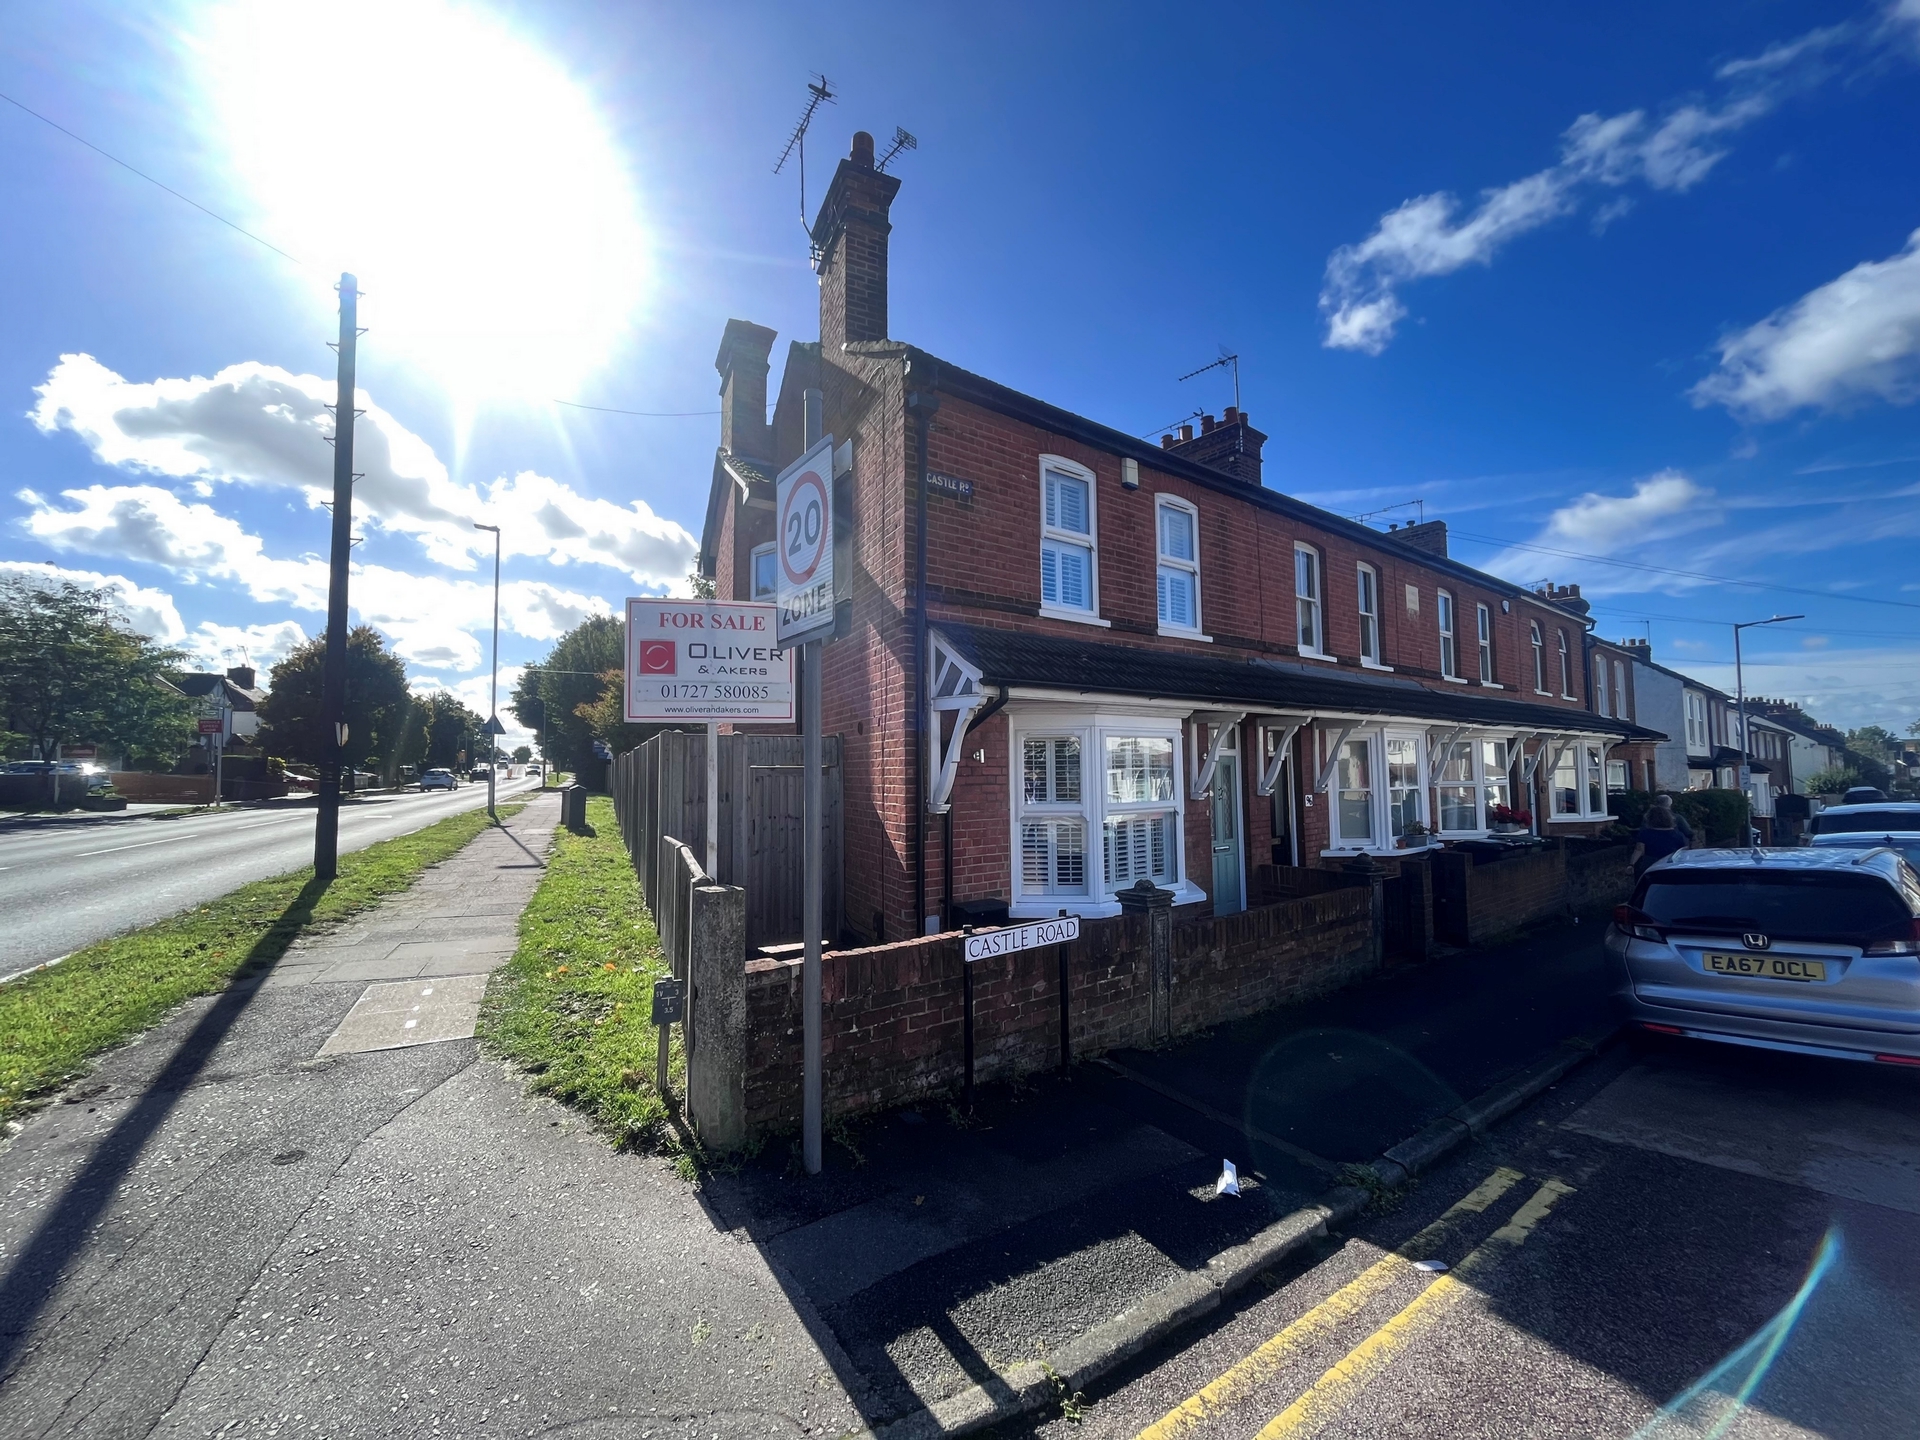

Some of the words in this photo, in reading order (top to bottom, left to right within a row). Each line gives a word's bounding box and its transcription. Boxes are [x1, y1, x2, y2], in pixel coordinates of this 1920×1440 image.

[926, 472, 957, 490] CASTLE
[788, 499, 820, 557] 20
[782, 582, 827, 627] ZONE
[659, 612, 705, 629] FOR
[710, 613, 766, 632] SALE
[688, 643, 784, 662] OLIVER
[697, 664, 710, 675] &
[716, 665, 768, 676] AKERS
[660, 684, 709, 699] 01727
[713, 685, 769, 700] 580085
[664, 706, 760, 714] www.oliverandakers.com
[968, 929, 1028, 958] CASTLE
[1036, 921, 1076, 944] ROAD
[1711, 955, 1765, 973] EA67
